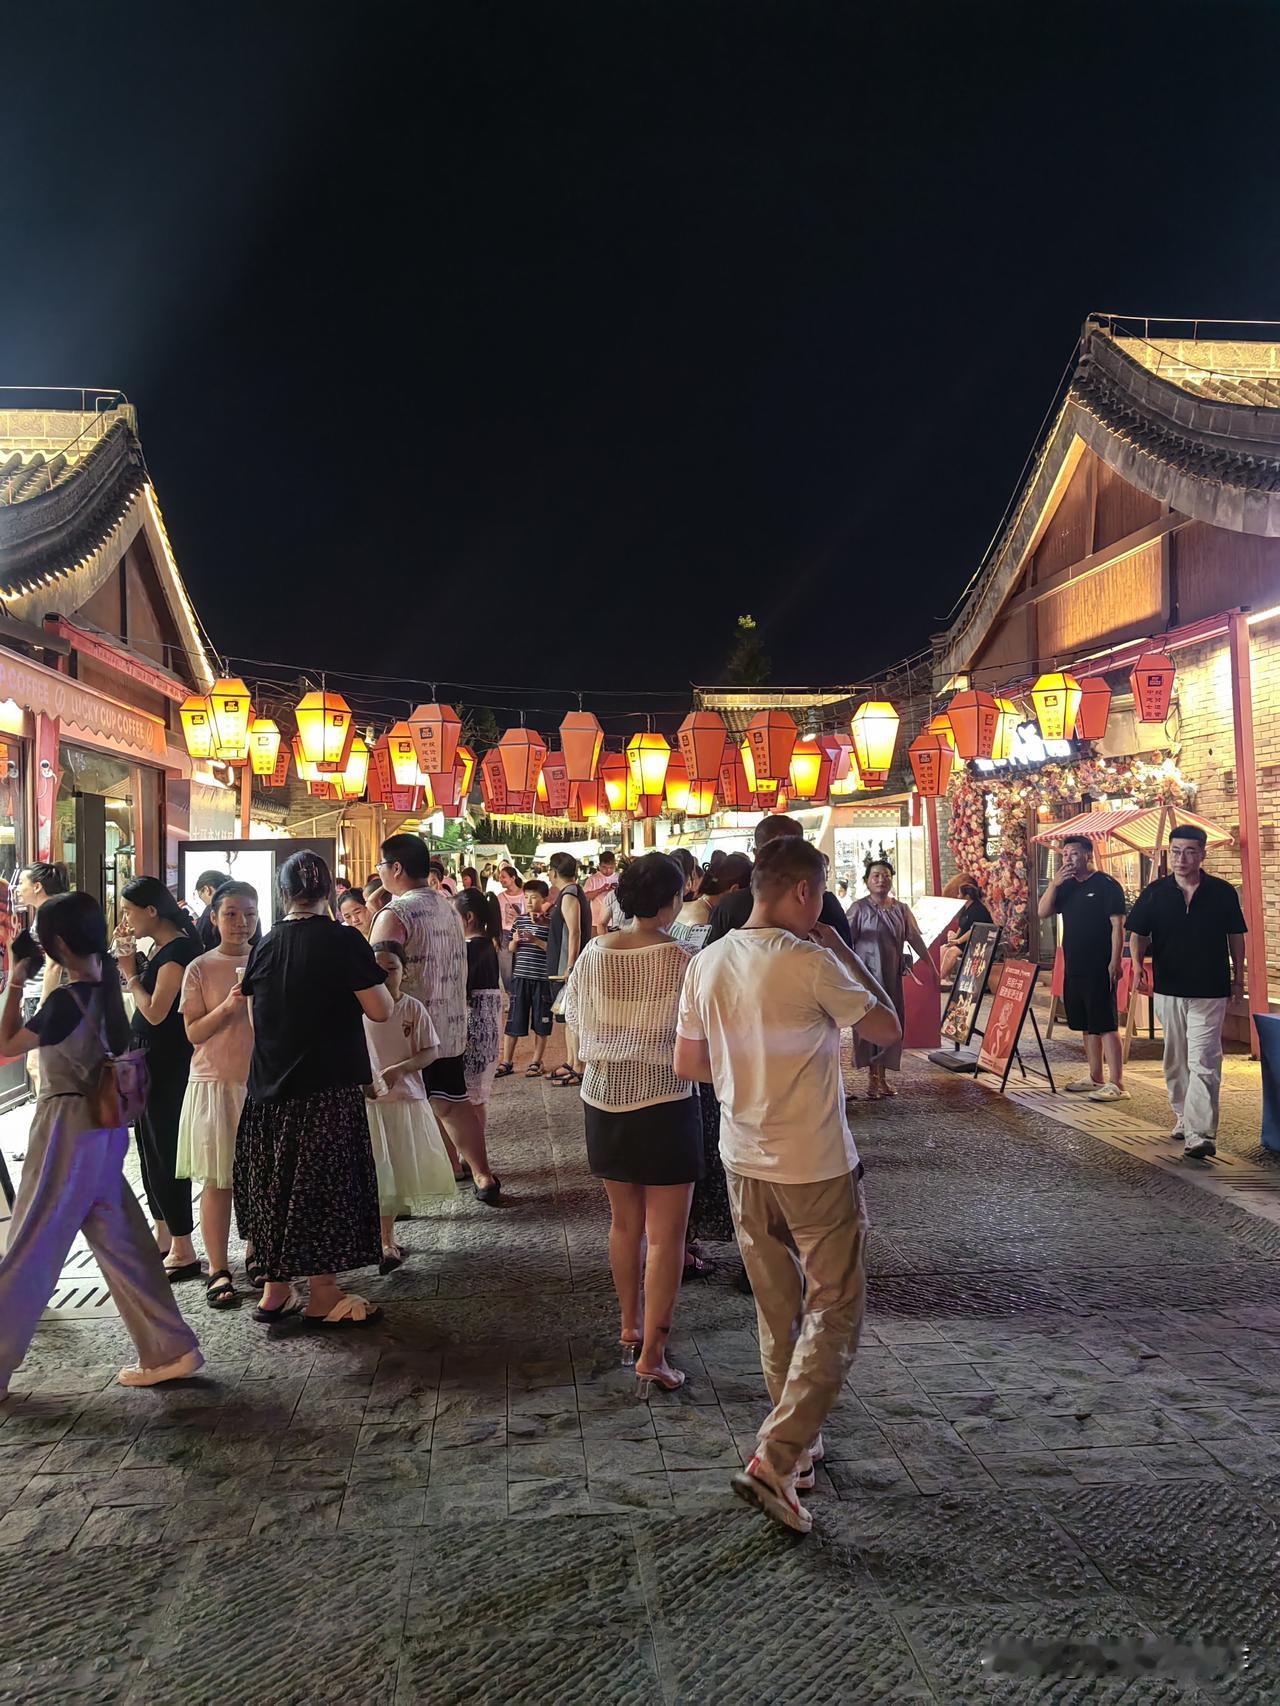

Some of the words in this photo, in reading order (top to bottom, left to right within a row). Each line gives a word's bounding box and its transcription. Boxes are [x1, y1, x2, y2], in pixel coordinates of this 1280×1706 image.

[8, 668, 49, 704] COFFEE
[71, 695, 98, 723] LUCKY
[100, 705, 116, 729] CUP
[117, 713, 144, 740] COFFEE
